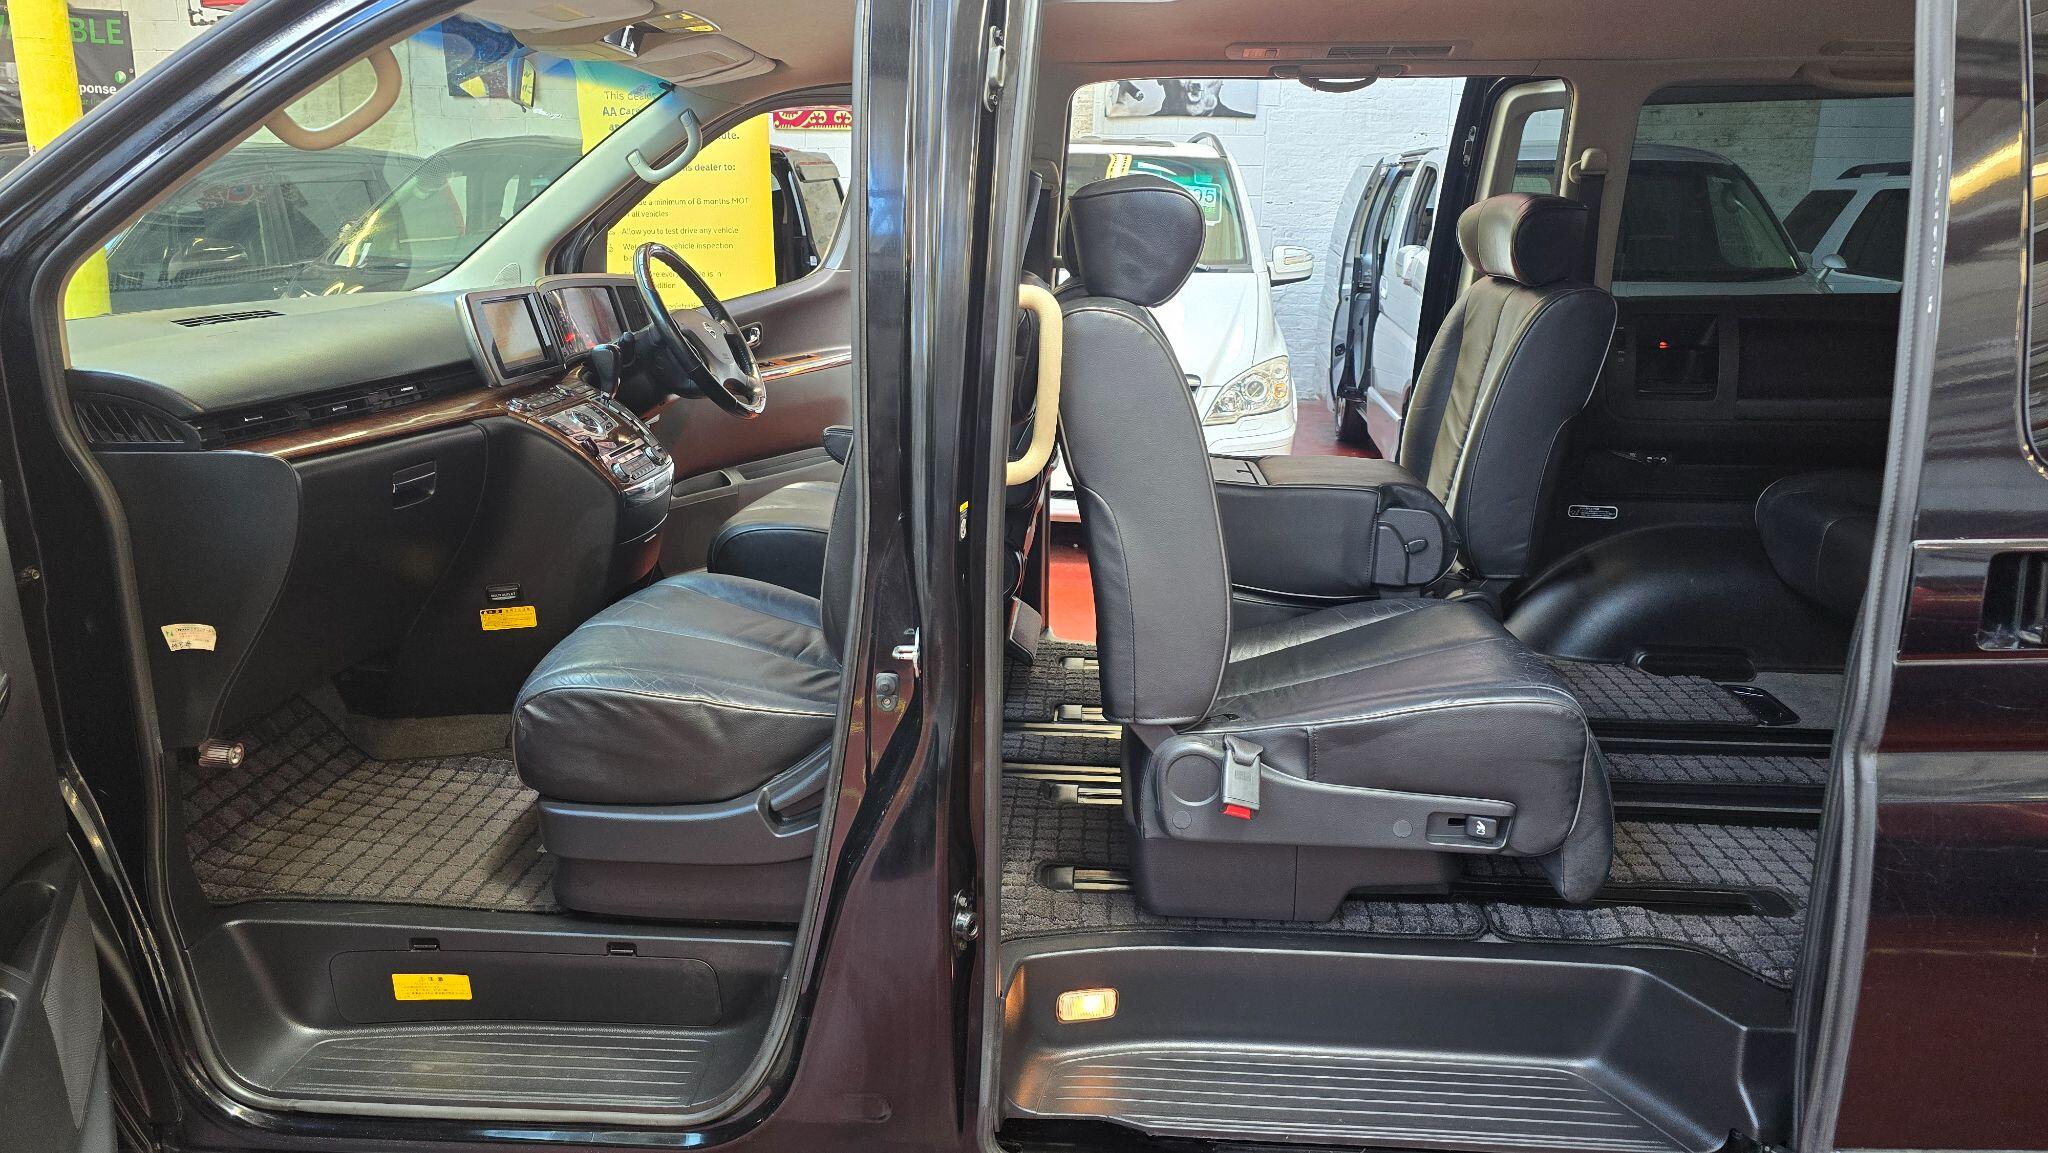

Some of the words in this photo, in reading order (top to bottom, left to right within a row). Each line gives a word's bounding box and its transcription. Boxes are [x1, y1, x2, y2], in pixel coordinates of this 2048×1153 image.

[603, 91, 625, 101] This
[602, 106, 618, 117] AA
[694, 163, 722, 172] dealer
[655, 198, 687, 206] minimum
[680, 227, 698, 235] drive
